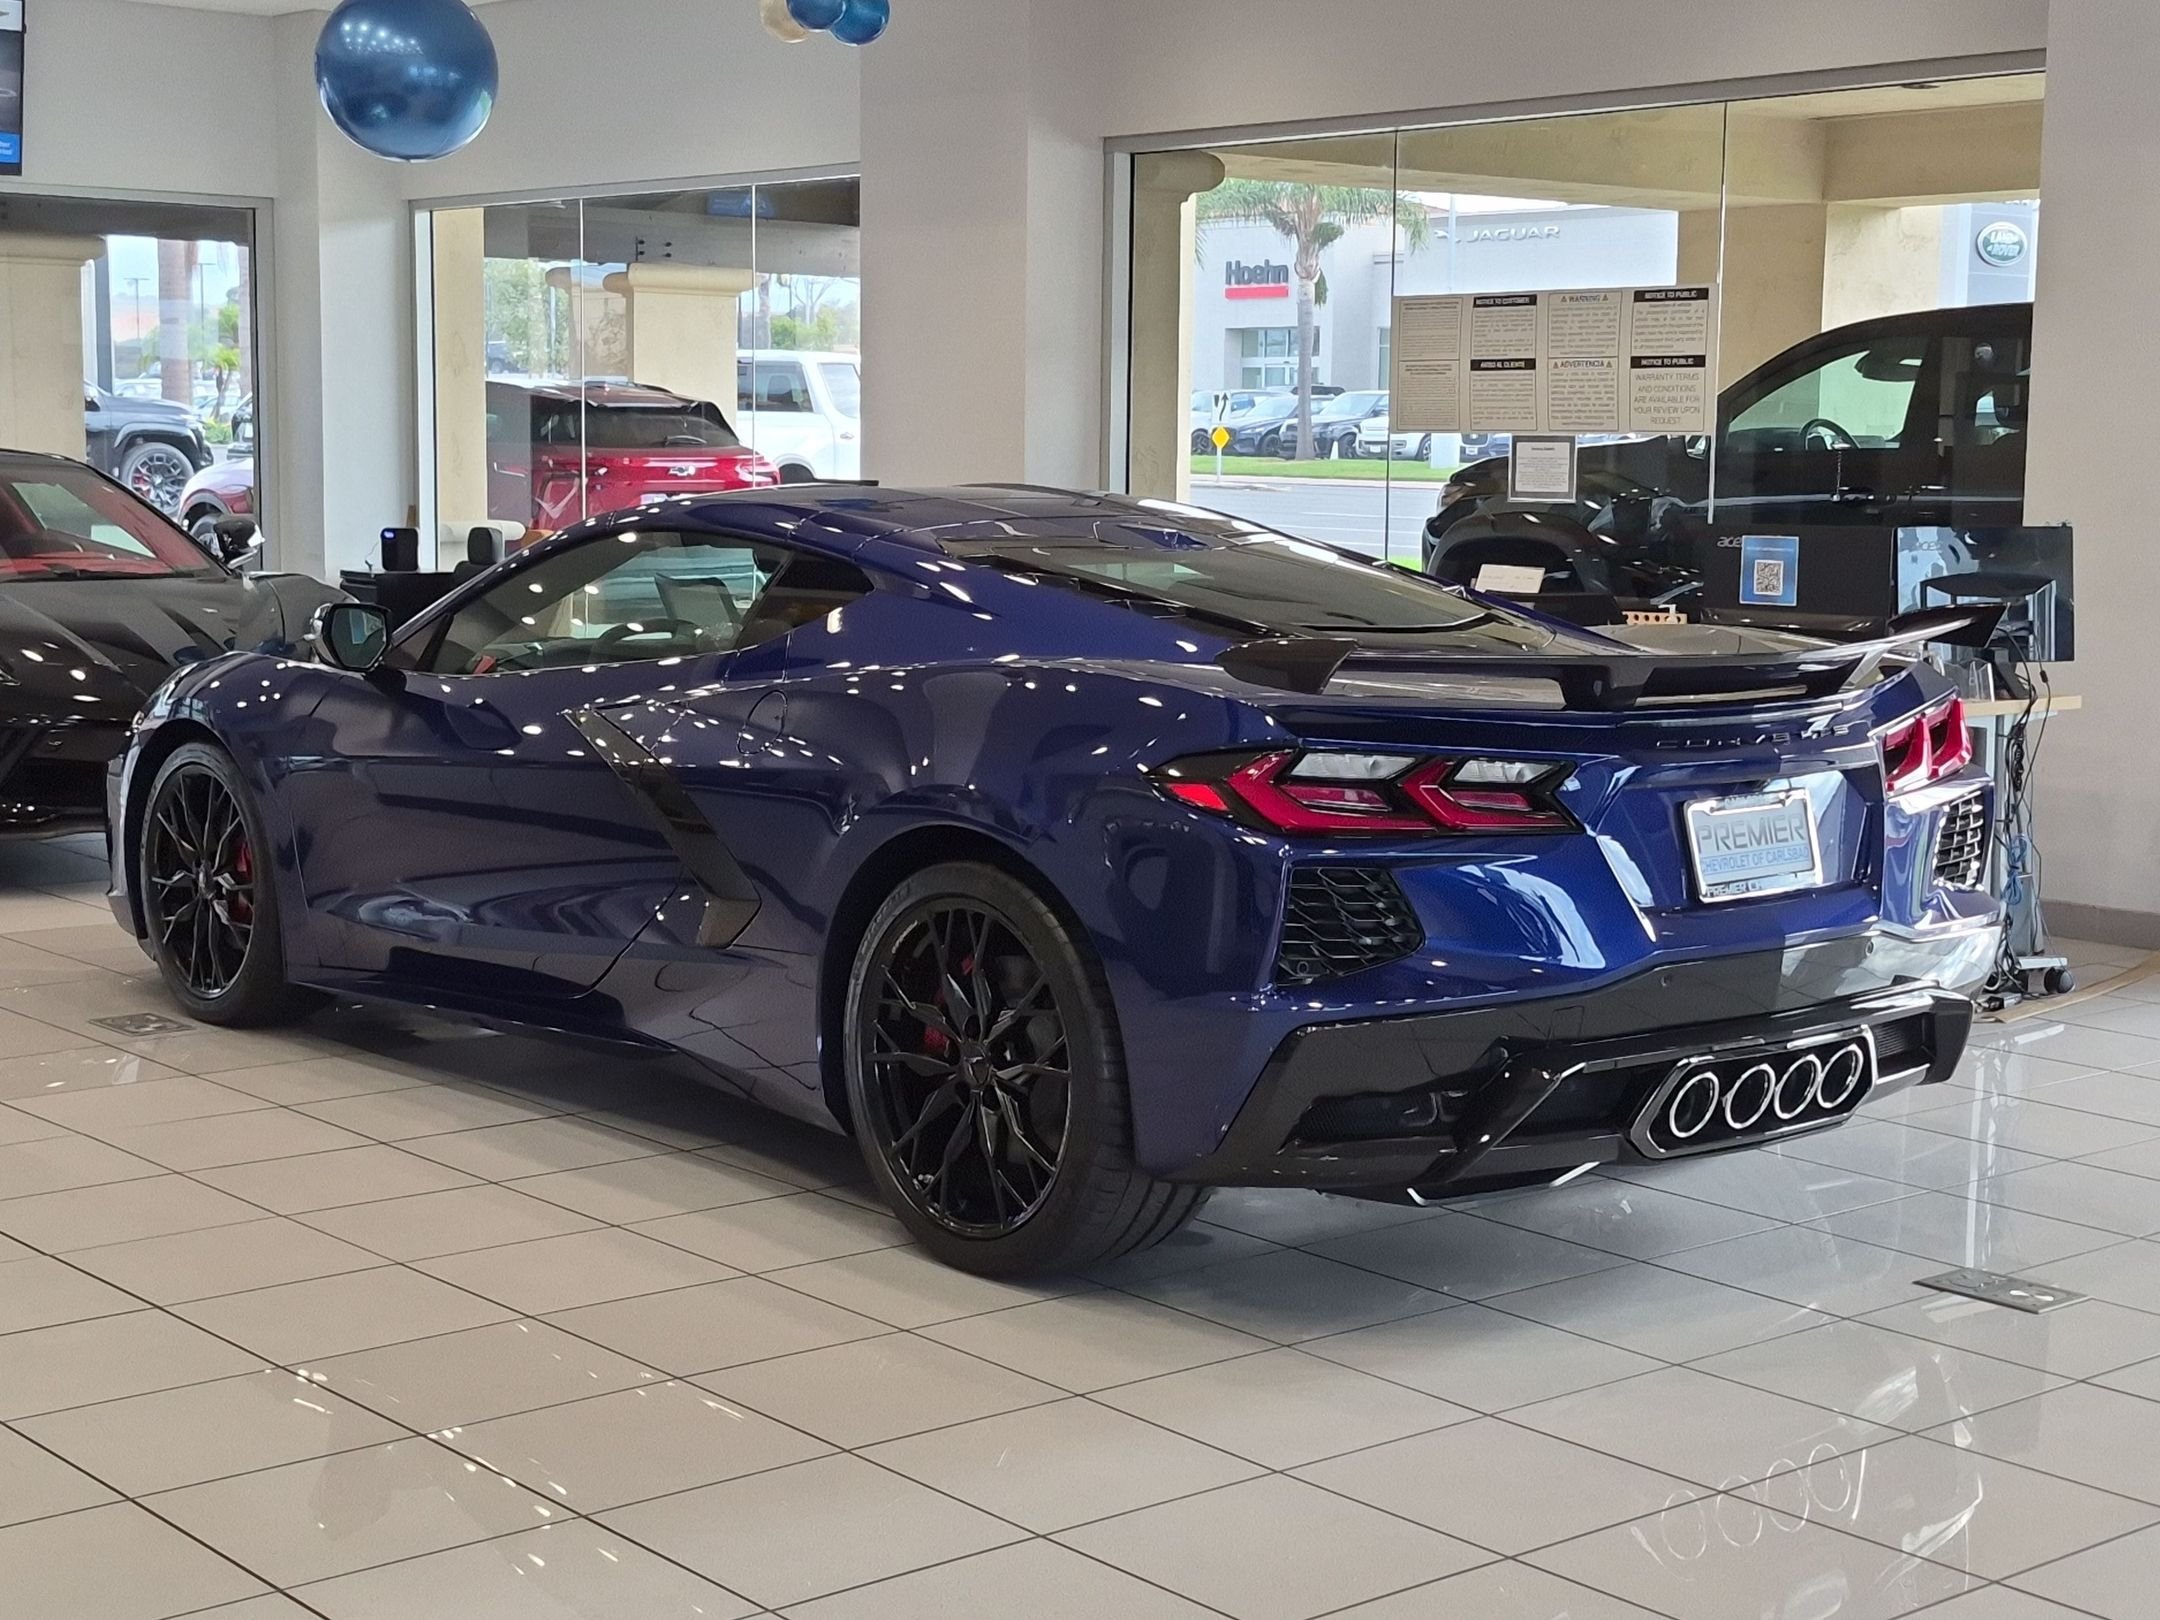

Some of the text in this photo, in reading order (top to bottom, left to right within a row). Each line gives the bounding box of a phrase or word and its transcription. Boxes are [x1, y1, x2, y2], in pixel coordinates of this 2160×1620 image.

[1466, 226, 1560, 243] JAGUAR
[1990, 231, 2019, 244] LAND
[1992, 244, 2020, 257] ROVER
[1225, 259, 1289, 285] Hoehn
[1675, 290, 1698, 298] PUBLIC
[1568, 295, 1600, 303] WARNING
[1560, 360, 1604, 369] ADVERTENCIA
[1641, 358, 1662, 366] NOTICE
[1672, 357, 1694, 365] PUBLIC
[1635, 372, 1700, 381] WARRANTY TERMS
[1638, 384, 1696, 393] AND CONDITIONS
[1634, 395, 1647, 403] ARE
[1648, 395, 1684, 403] AVAILABLE
[1653, 406, 1679, 414] REVIEW
[1680, 406, 1700, 414] UPON
[1717, 536, 1743, 547] ace
[1698, 814, 1806, 853] PREMIER
[1752, 853, 1766, 866] OF
[1767, 847, 1810, 863] CARLSBAD
